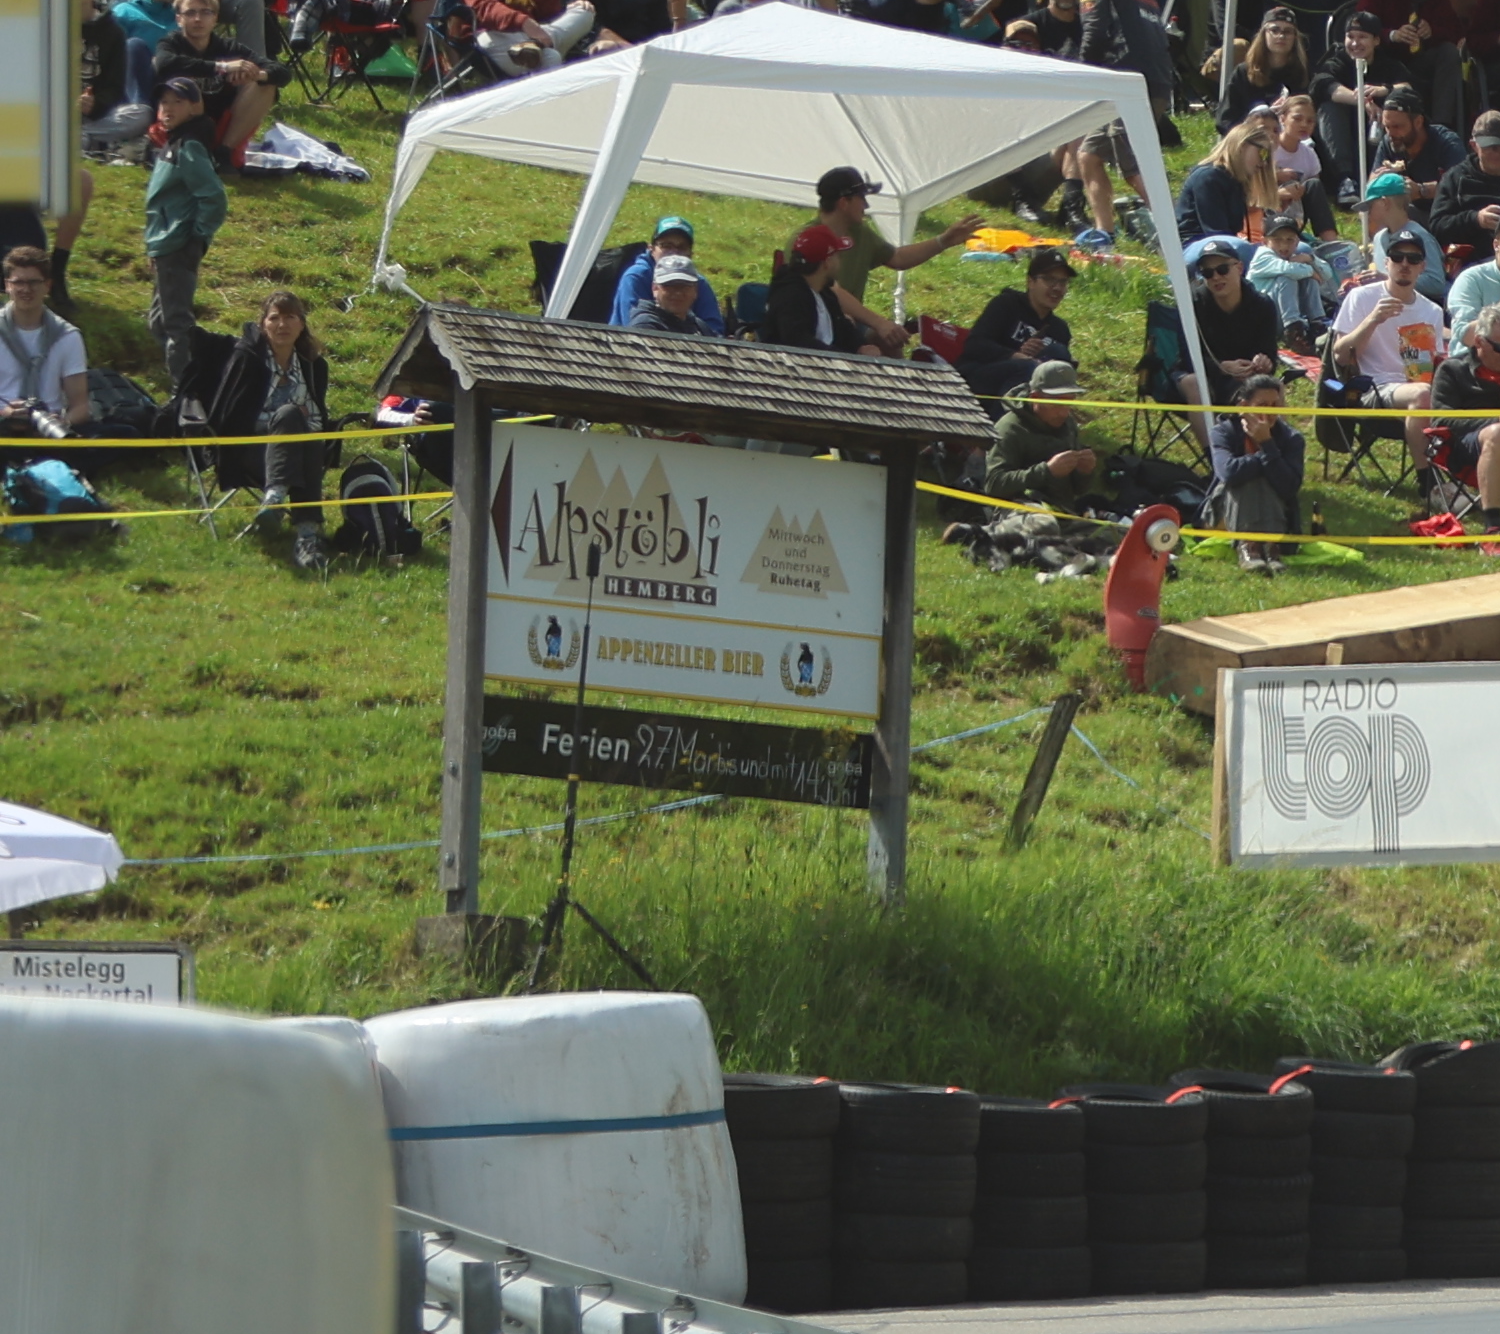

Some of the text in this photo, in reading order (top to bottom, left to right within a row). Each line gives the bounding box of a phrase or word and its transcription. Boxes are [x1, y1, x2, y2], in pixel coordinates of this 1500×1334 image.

[513, 480, 720, 580] Alpstöbli
[768, 528, 825, 546] Mittwoch
[762, 555, 831, 578] Donnerstag
[785, 548, 807, 559] und
[607, 576, 714, 604] HEMBERG
[770, 572, 821, 592] Ruhetag
[597, 635, 765, 677] APPENZELLER BIER
[1302, 677, 1399, 713] RADIO
[13, 956, 126, 984] Mistelegg
